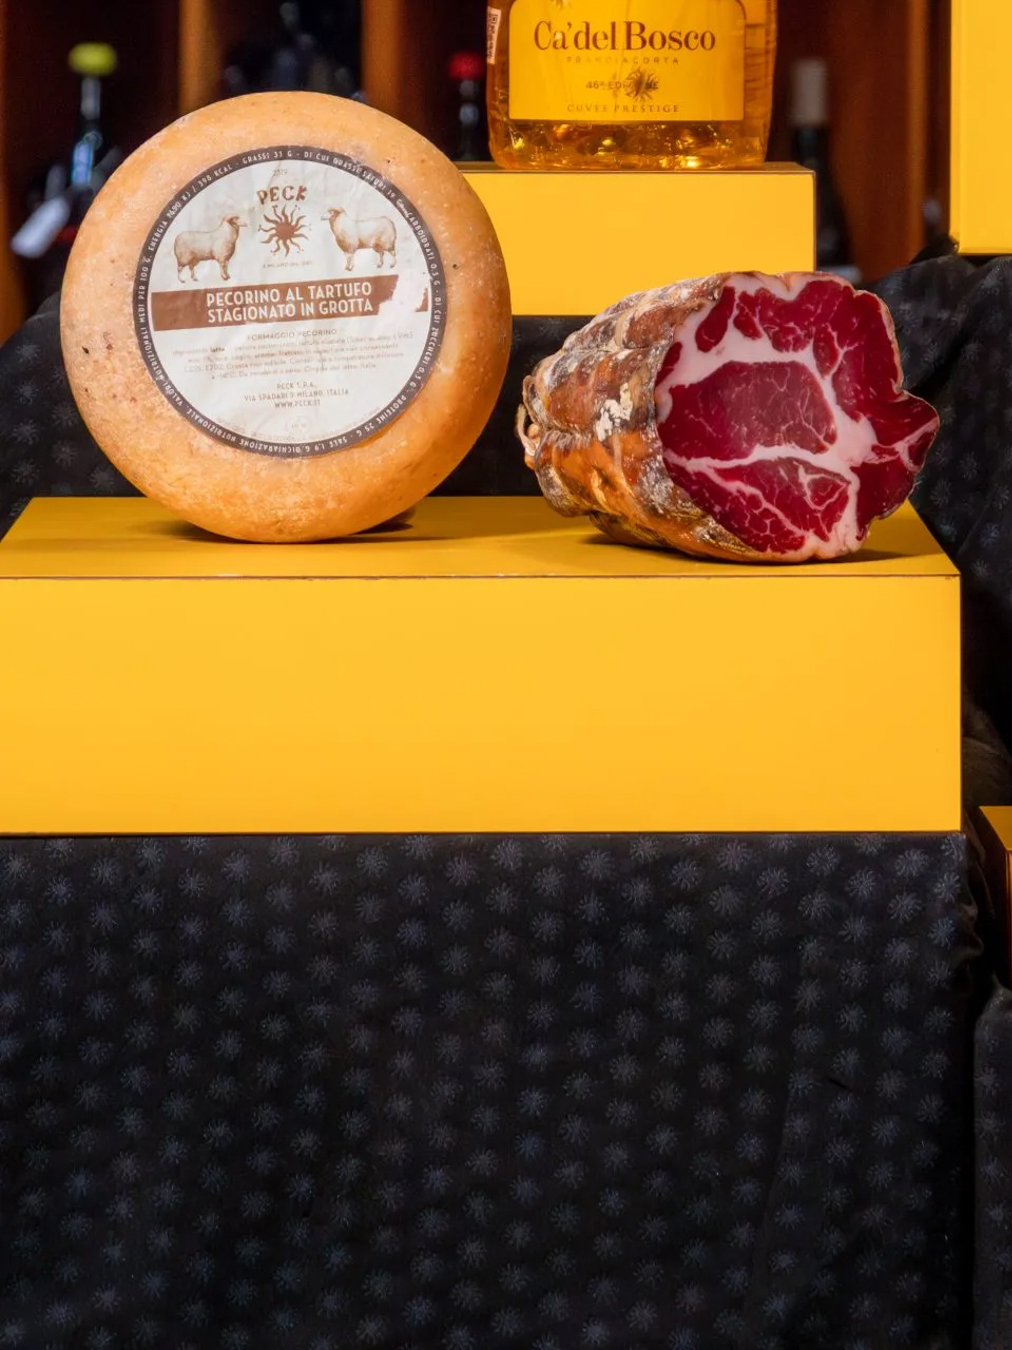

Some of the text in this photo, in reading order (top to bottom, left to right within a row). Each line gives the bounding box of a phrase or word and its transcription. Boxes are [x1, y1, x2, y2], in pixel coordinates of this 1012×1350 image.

[625, 21, 716, 51] Bosco
[614, 103, 679, 113] PRESTIGE
[241, 151, 269, 164] GRASSI
[315, 152, 329, 161] CUI
[212, 162, 232, 176] KCAL
[256, 185, 308, 205] PECK
[147, 219, 168, 251] ENERGIA
[139, 266, 149, 281] 100
[206, 281, 372, 307] PECORINO AL TARTUFO
[138, 304, 146, 322] MEDI
[208, 298, 373, 323] STAGIONATO IN GROTTA
[433, 309, 441, 323] CUI
[163, 380, 184, 405] VALORI
